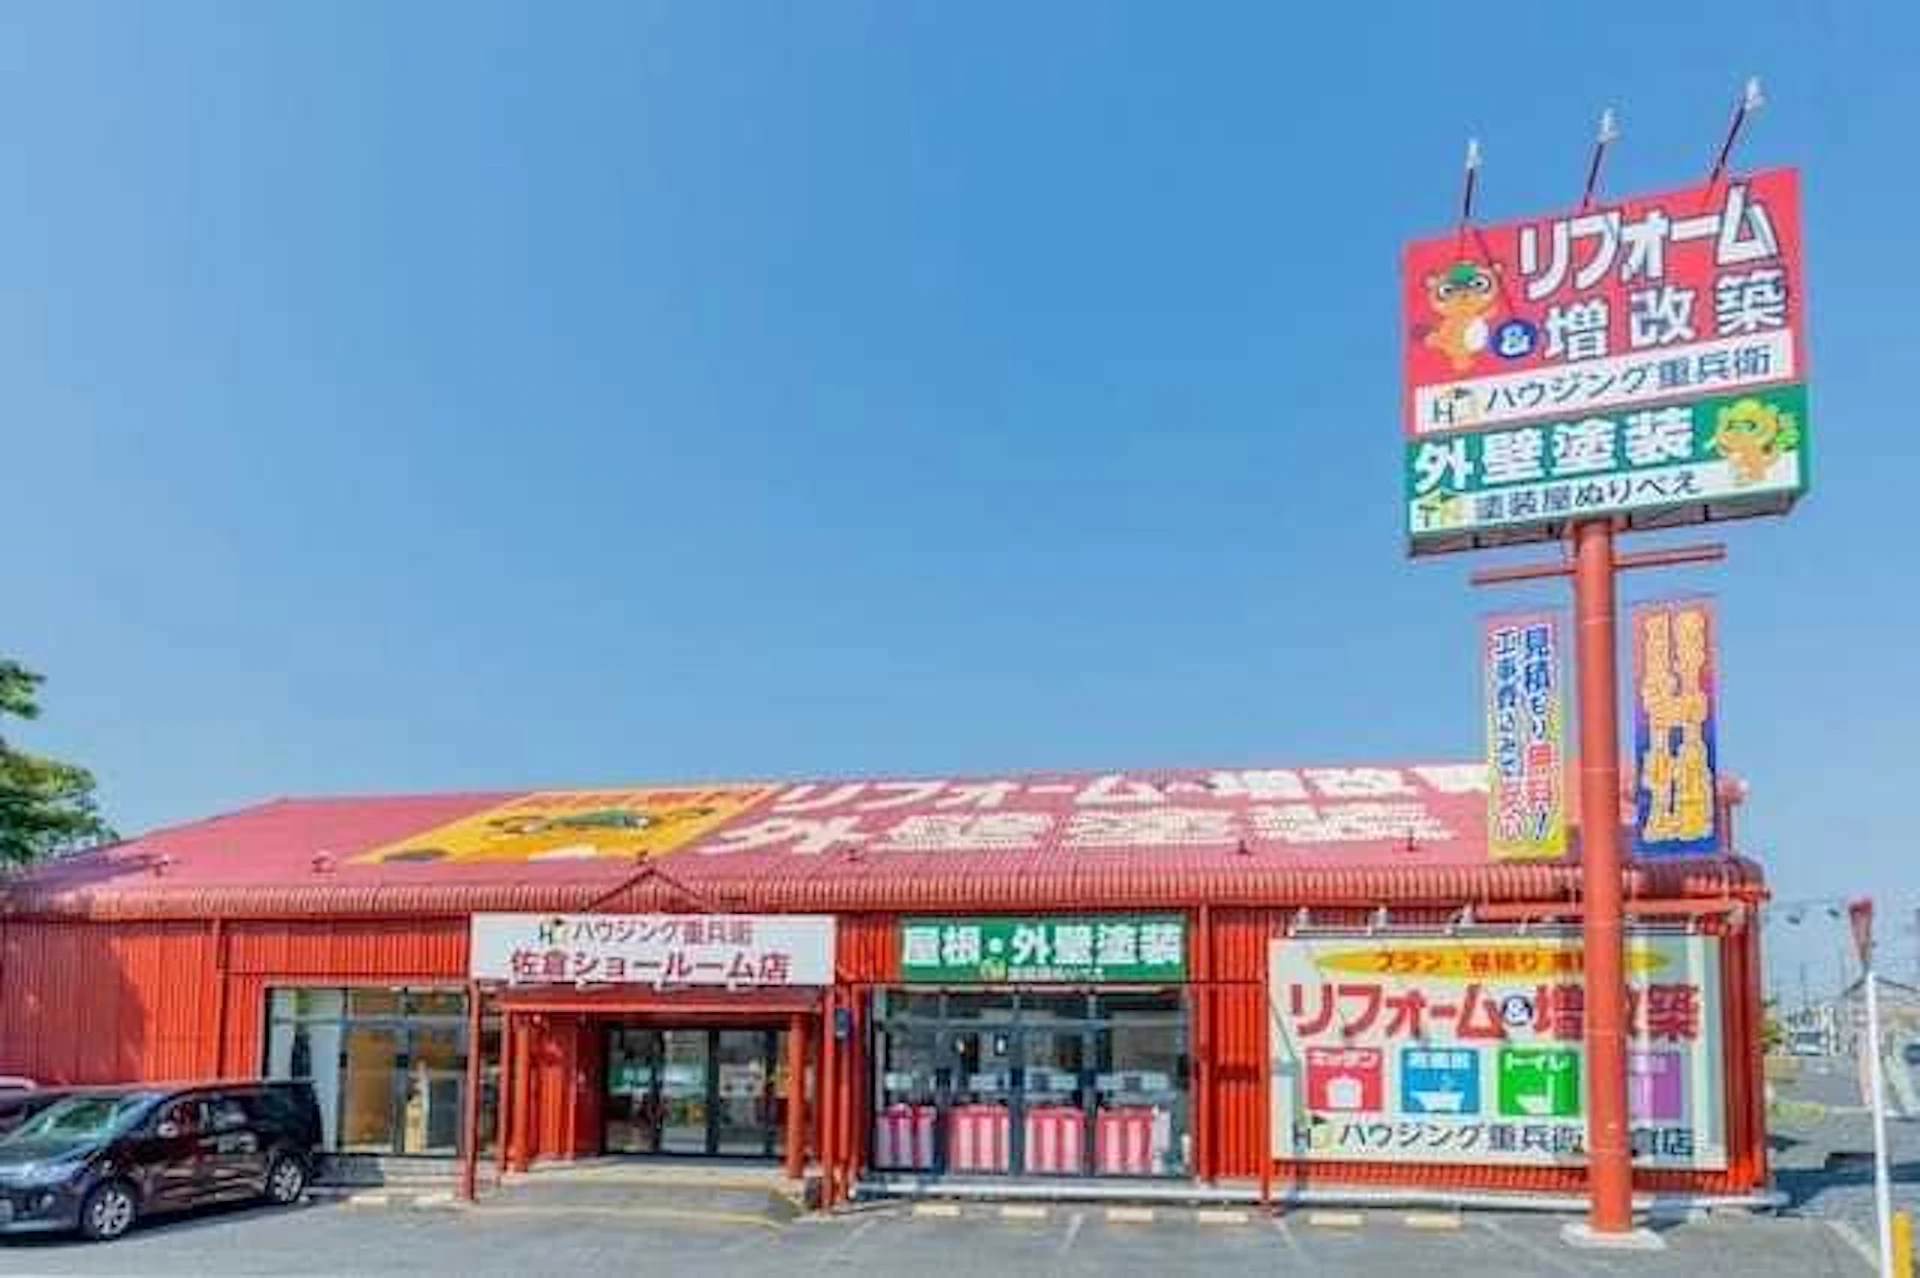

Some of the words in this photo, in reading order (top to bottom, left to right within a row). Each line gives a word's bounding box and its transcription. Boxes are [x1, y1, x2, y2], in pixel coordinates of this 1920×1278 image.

[1516, 181, 1779, 300] リフォーム
[1487, 345, 1771, 412] ハウジング重兵衛
[1414, 406, 1695, 495] 外壁塗装
[509, 950, 792, 981] 佐倉ショールーム店
[903, 923, 1184, 967] 屋根・外壁塗装
[1505, 1052, 1567, 1071] トイレ
